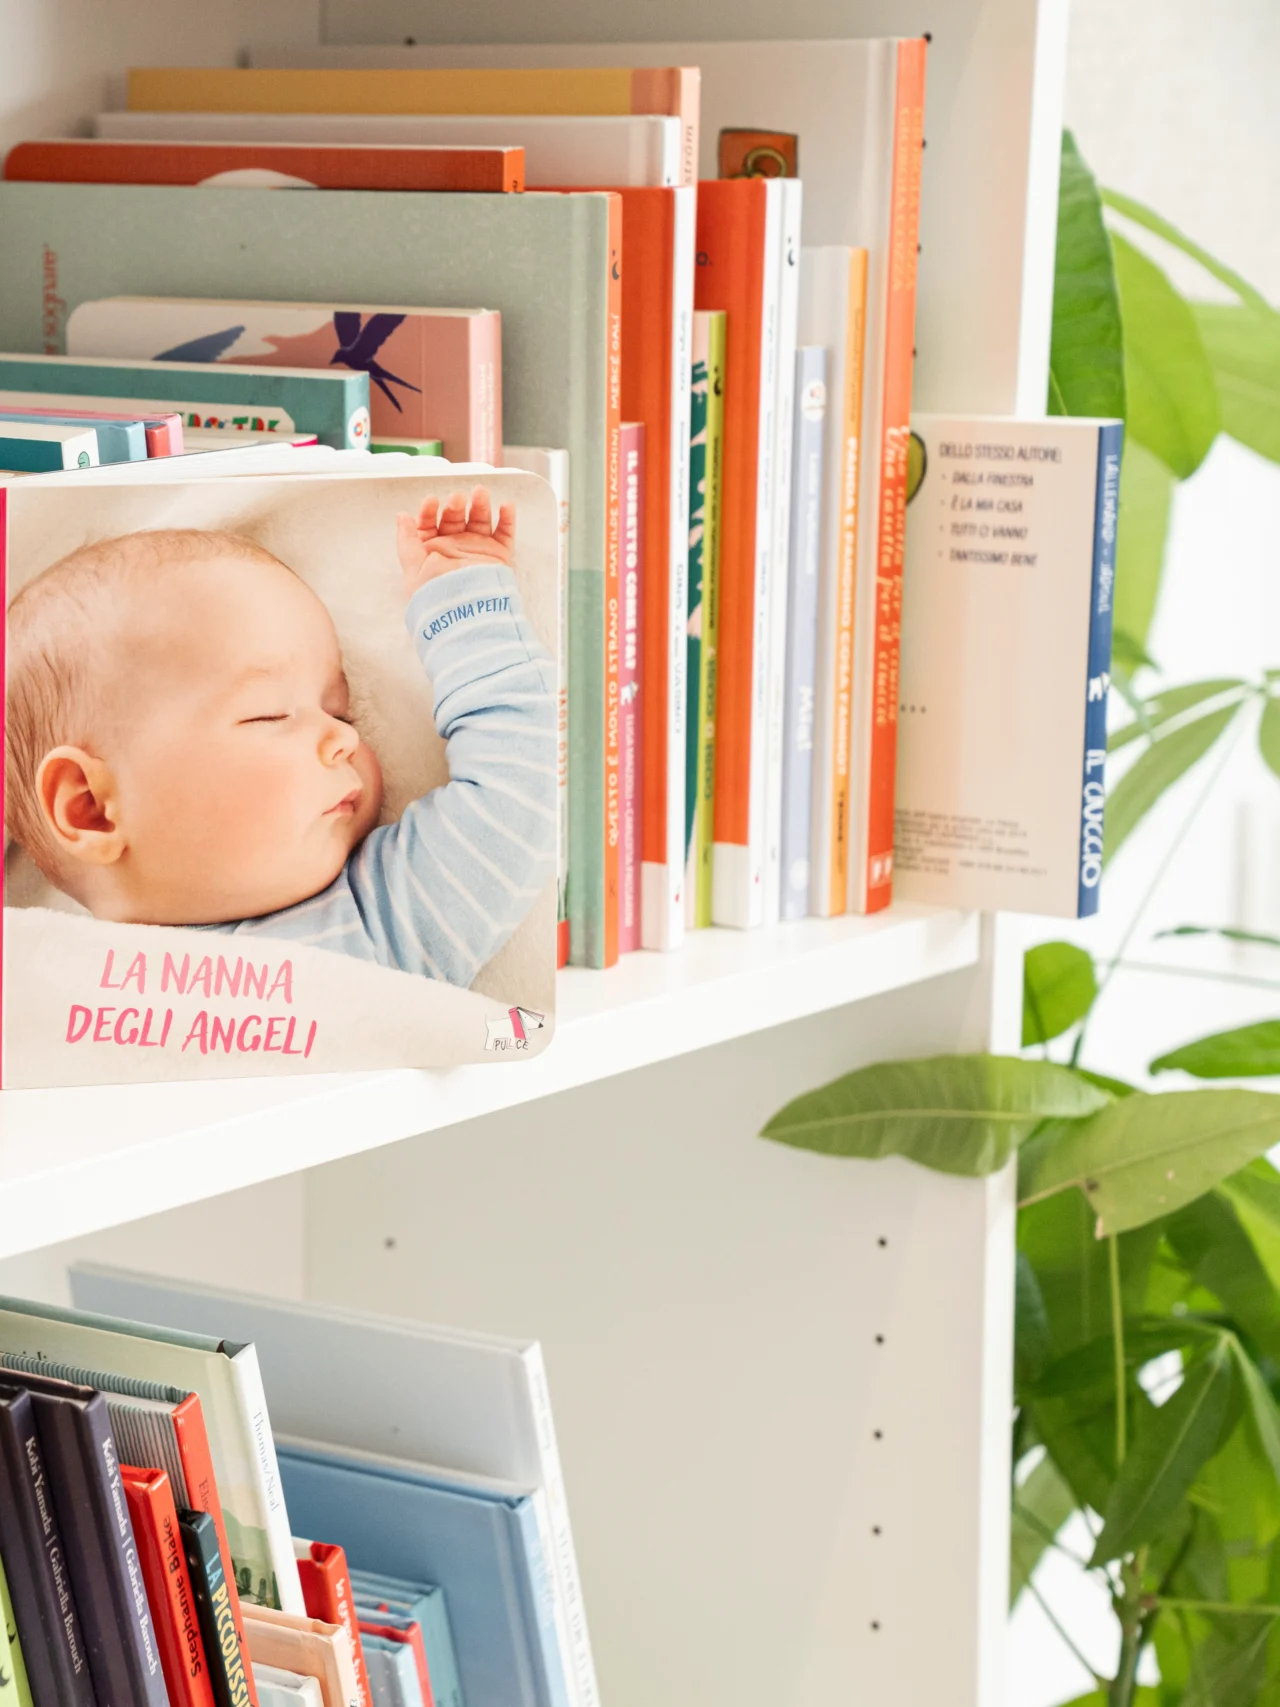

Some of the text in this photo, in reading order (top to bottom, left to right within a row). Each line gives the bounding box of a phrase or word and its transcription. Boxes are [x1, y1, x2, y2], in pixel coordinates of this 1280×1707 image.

[627, 451, 639, 470] IL
[939, 443, 1063, 463] DELLO STESSO AUTORE:
[952, 471, 1034, 488] DALLA FINESTRA
[951, 522, 977, 537] TUTTI
[992, 524, 1029, 540] VANNO
[960, 498, 972, 511] LA
[976, 499, 994, 512] MIA
[997, 500, 1023, 514] CASA
[609, 503, 618, 577] MATILDE
[422, 596, 510, 640] CRISTINA PETIT
[608, 598, 619, 674] STRANO
[608, 680, 618, 748] MOLTO
[1086, 748, 1107, 775] IL
[607, 775, 619, 848] QUESTO
[100, 947, 293, 1004] LA NANNA
[65, 1004, 319, 1059] DEGLI ANGELI
[494, 1037, 530, 1051] PULCE
[24, 1434, 43, 1477] Kobi
[101, 1436, 120, 1478] Kobi
[33, 1474, 52, 1537] Yamada
[110, 1475, 128, 1540] Yamada
[197, 1477, 211, 1513] Elis
[49, 1546, 70, 1616] Gabriella
[124, 1547, 145, 1617] Gabriella
[162, 1515, 203, 1679] Stephanie Blake
[63, 1612, 84, 1675] Barouch
[138, 1613, 158, 1677] Barouch
[205, 1551, 255, 1707] LA PICCOLISSI
